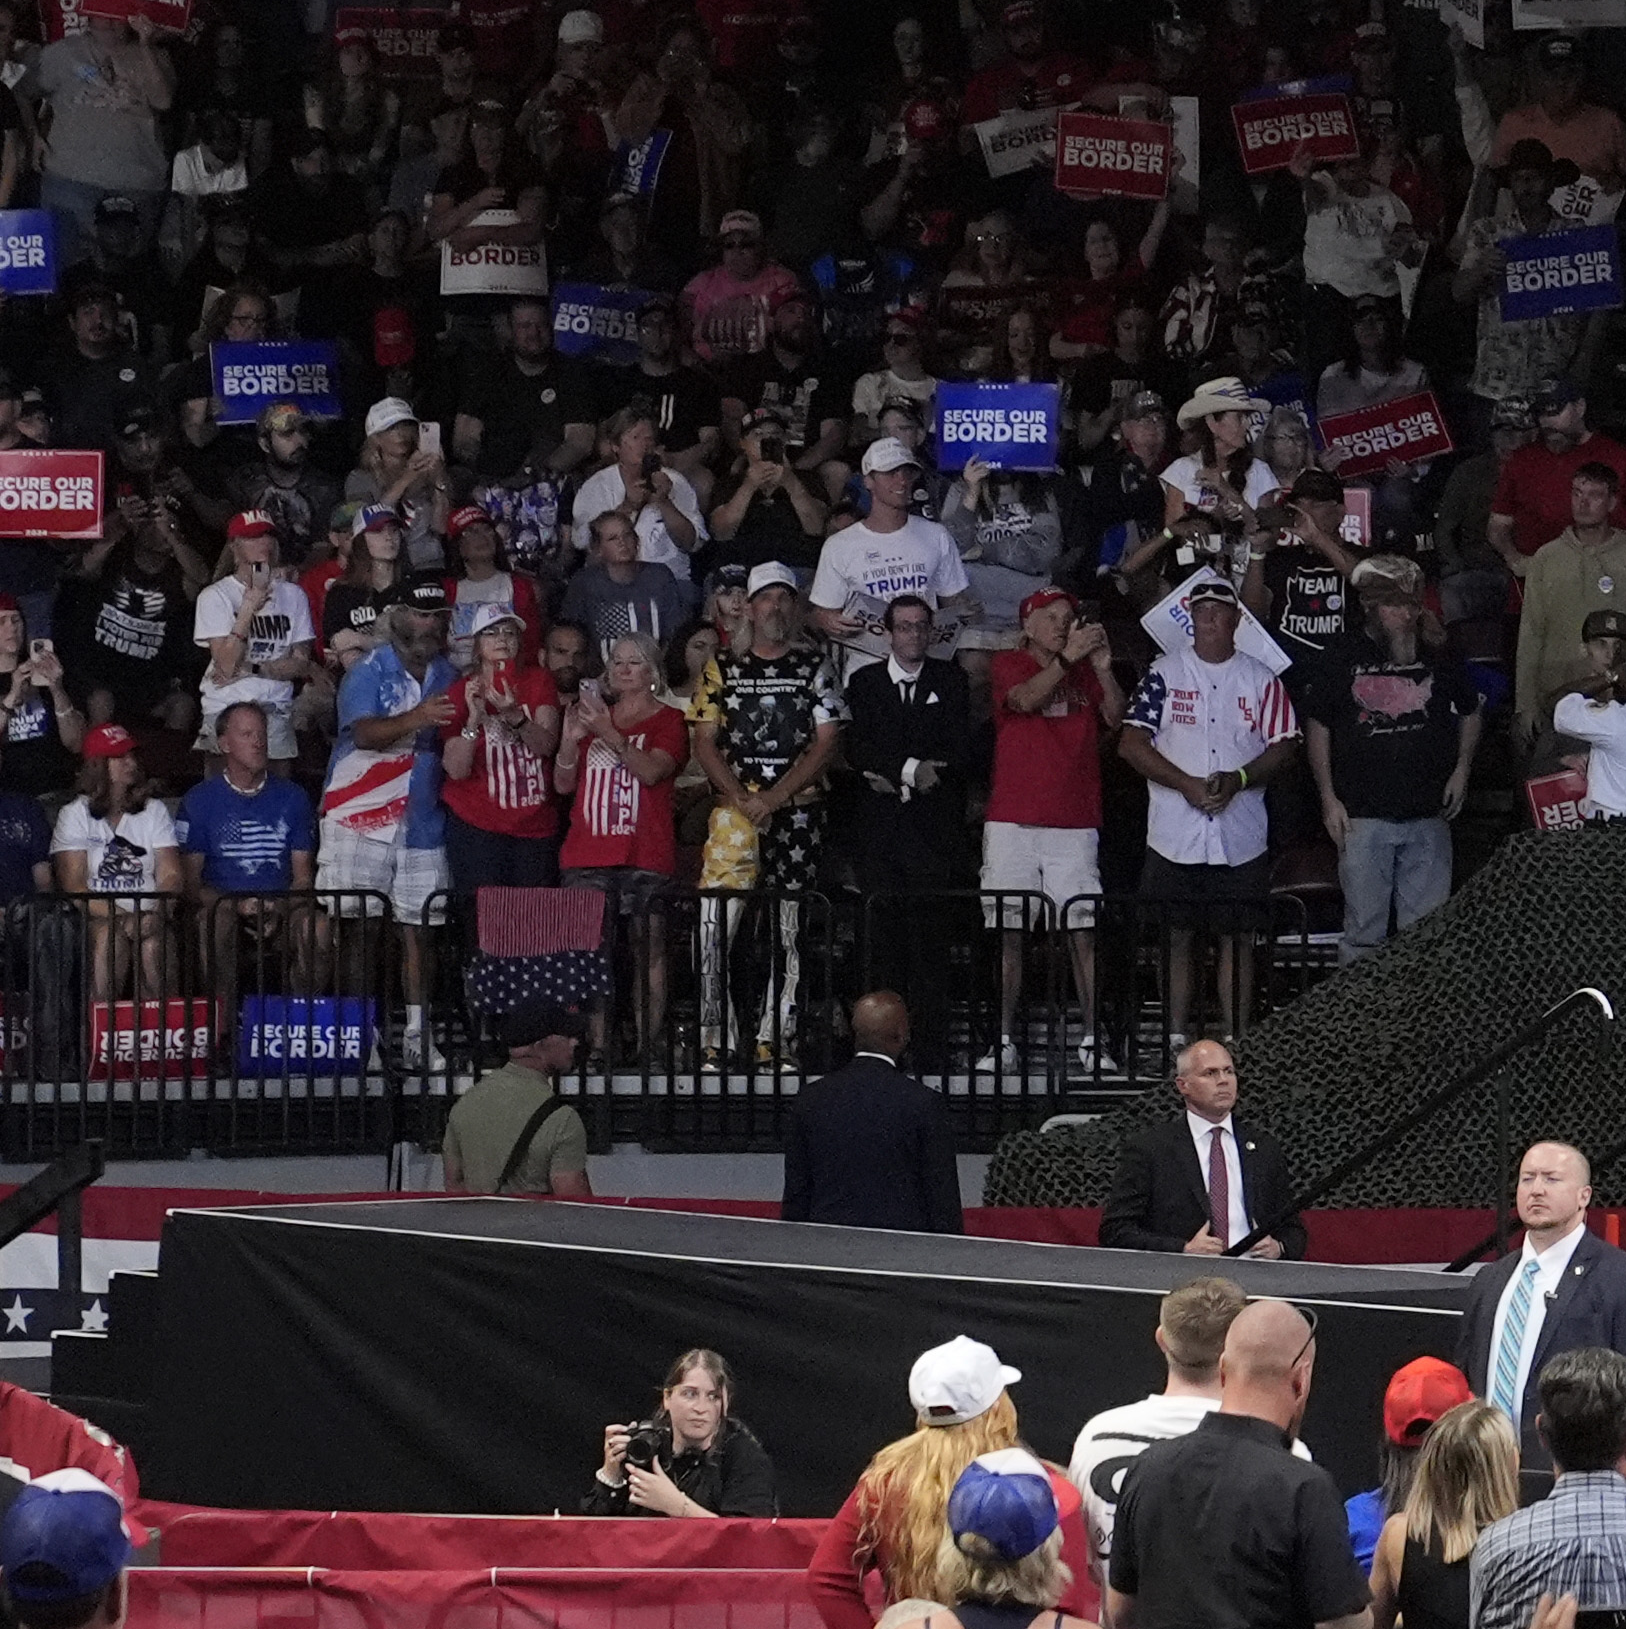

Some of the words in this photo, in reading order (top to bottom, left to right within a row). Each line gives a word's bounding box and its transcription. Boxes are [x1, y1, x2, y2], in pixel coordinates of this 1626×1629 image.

[1243, 117, 1303, 140] SECURE
[1307, 110, 1345, 130] OUR
[1245, 122, 1348, 148] BORDER
[1065, 135, 1121, 159] SECURE
[1129, 140, 1164, 158] OUR
[1063, 149, 1165, 174] BORDER
[450, 248, 541, 269] BORDER
[1506, 257, 1566, 275] SECURE
[1572, 252, 1610, 268] OUR
[1507, 267, 1613, 295] BORDER
[223, 365, 286, 379] SECURE
[291, 364, 325, 378] OUR
[223, 376, 331, 396] BORDER
[943, 409, 1001, 426] SECURE
[1008, 409, 1046, 426] OUR
[943, 423, 1047, 445] BORDER
[1331, 428, 1391, 454] SECURE
[1395, 417, 1436, 438] OUR
[866, 577, 927, 594] TRUMP
[1299, 576, 1338, 595] TEAM
[1289, 614, 1343, 634] TRUMP
[94, 628, 160, 661] TRUMP
[756, 686, 797, 694] COUNTRY
[1166, 689, 1200, 700] FRONT
[1172, 702, 1194, 712] ROW
[1170, 713, 1196, 725] JOES
